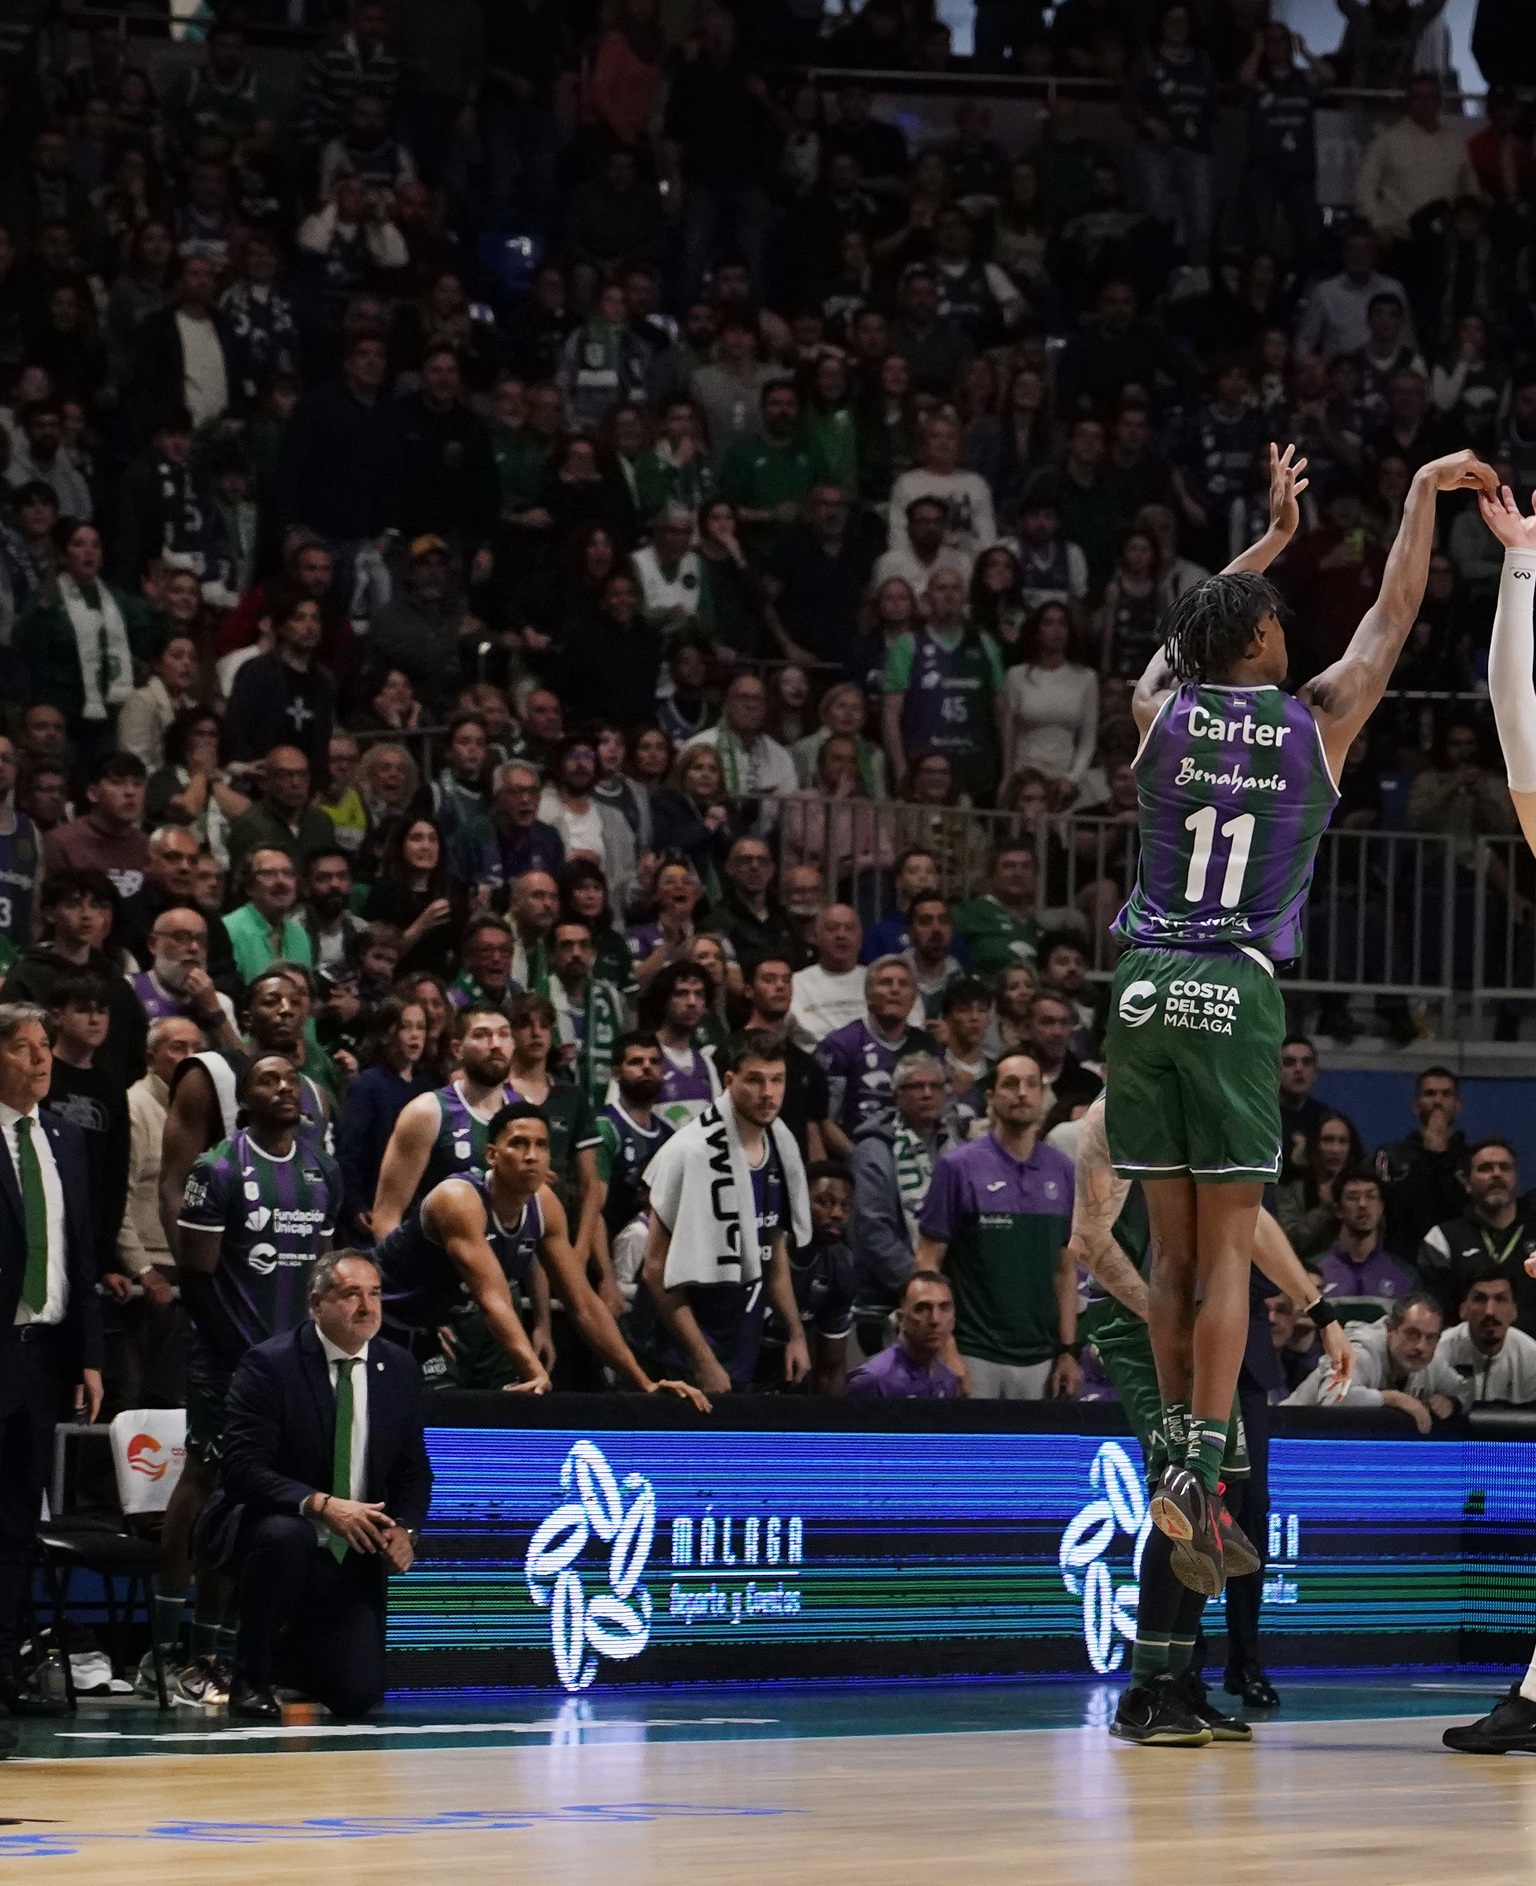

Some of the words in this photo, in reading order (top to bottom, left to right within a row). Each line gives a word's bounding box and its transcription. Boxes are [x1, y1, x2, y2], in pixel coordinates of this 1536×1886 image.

[1187, 705, 1292, 747] Carter
[1184, 805, 1256, 909] 11
[1168, 980, 1241, 1005] COSTA
[1165, 997, 1200, 1014] DEL
[1202, 1001, 1237, 1021] SOL
[1163, 1013, 1233, 1036] MÁLAGA
[273, 1208, 325, 1223] Fundación
[273, 1220, 313, 1237] Unicaja
[671, 1504, 803, 1566] MÁLAGA
